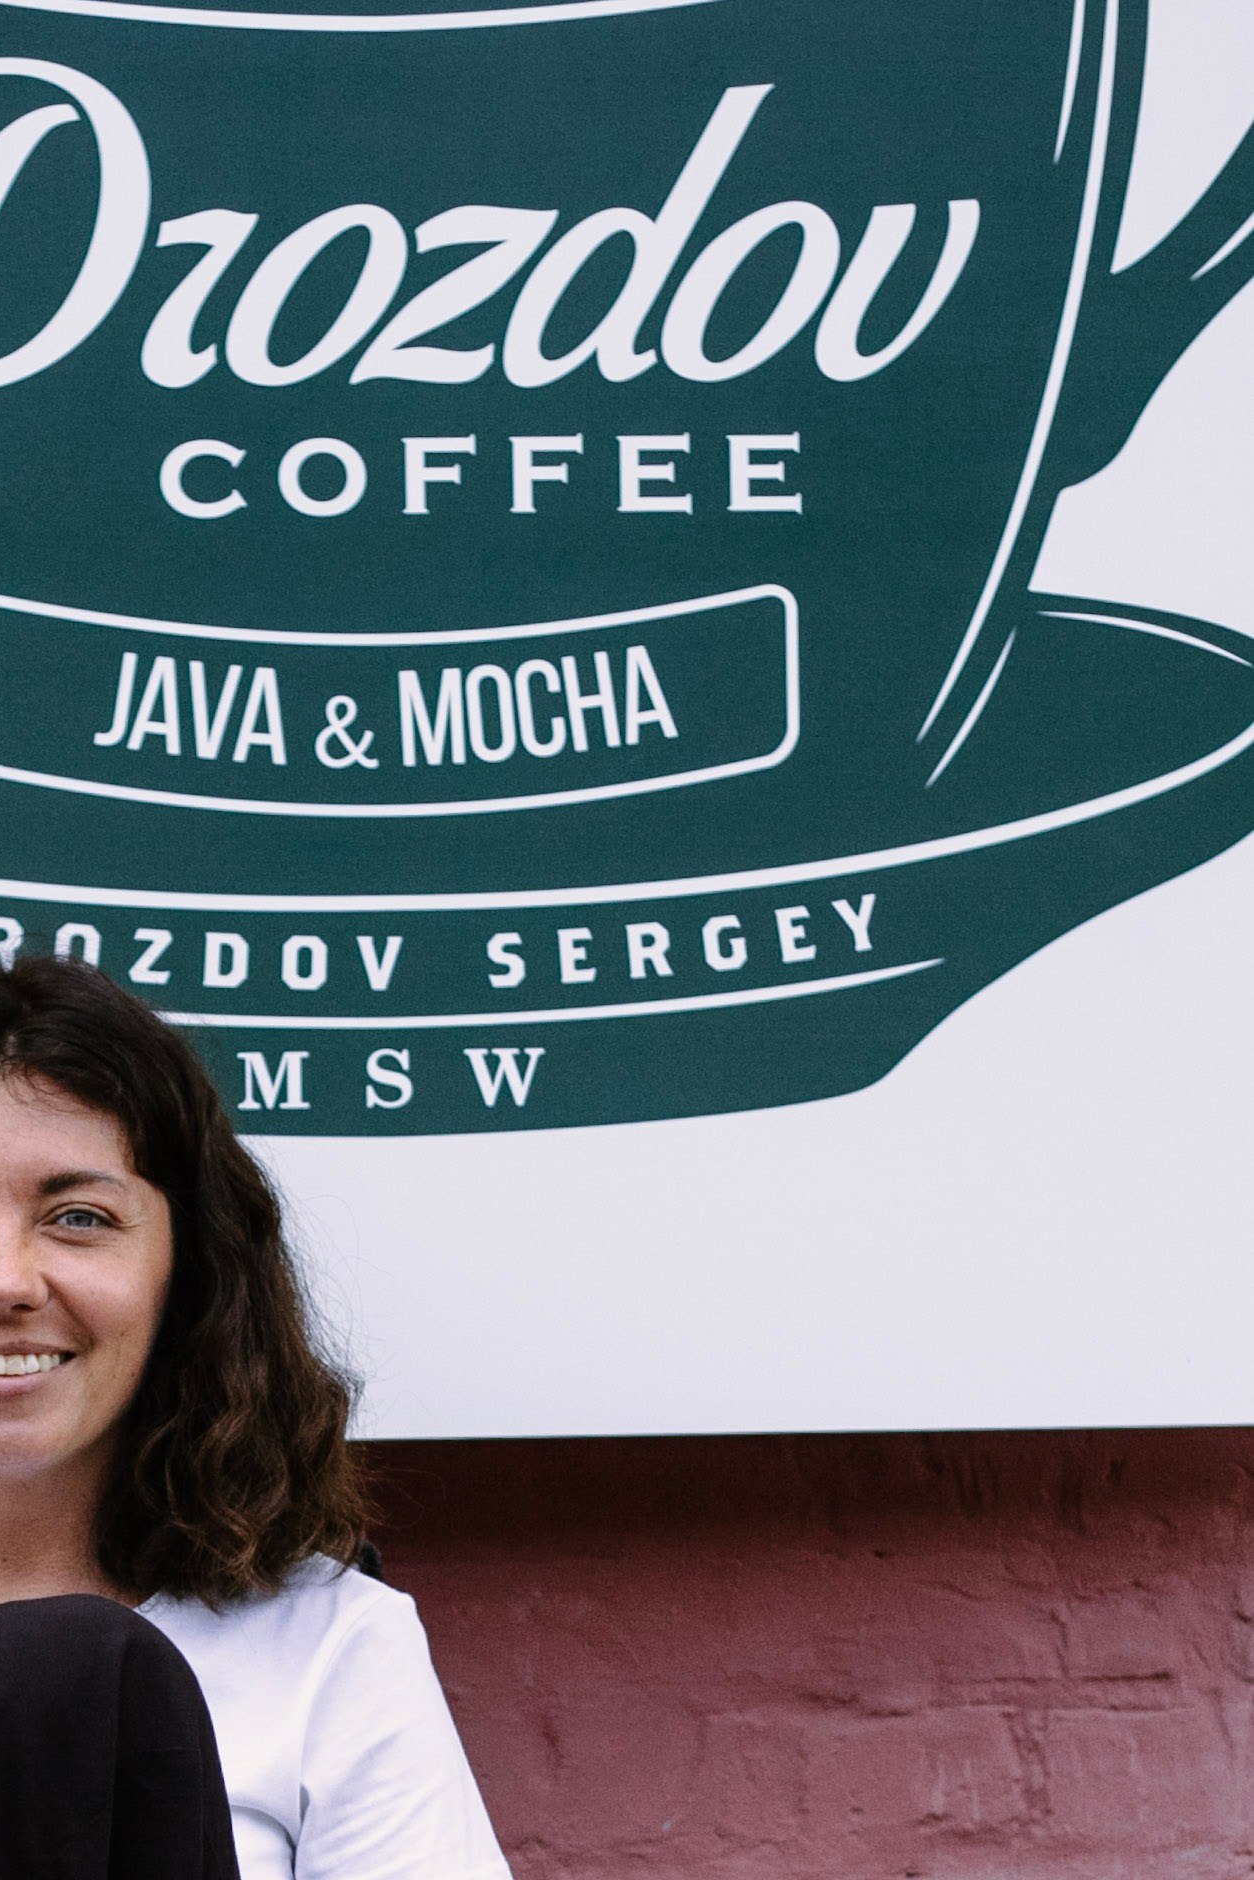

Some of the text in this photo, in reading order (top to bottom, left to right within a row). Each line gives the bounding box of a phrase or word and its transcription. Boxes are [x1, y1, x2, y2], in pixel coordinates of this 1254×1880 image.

[159, 431, 802, 519] COFFEE
[93, 644, 679, 770] JAVA & MOCHA
[486, 893, 877, 989] SERGEY
